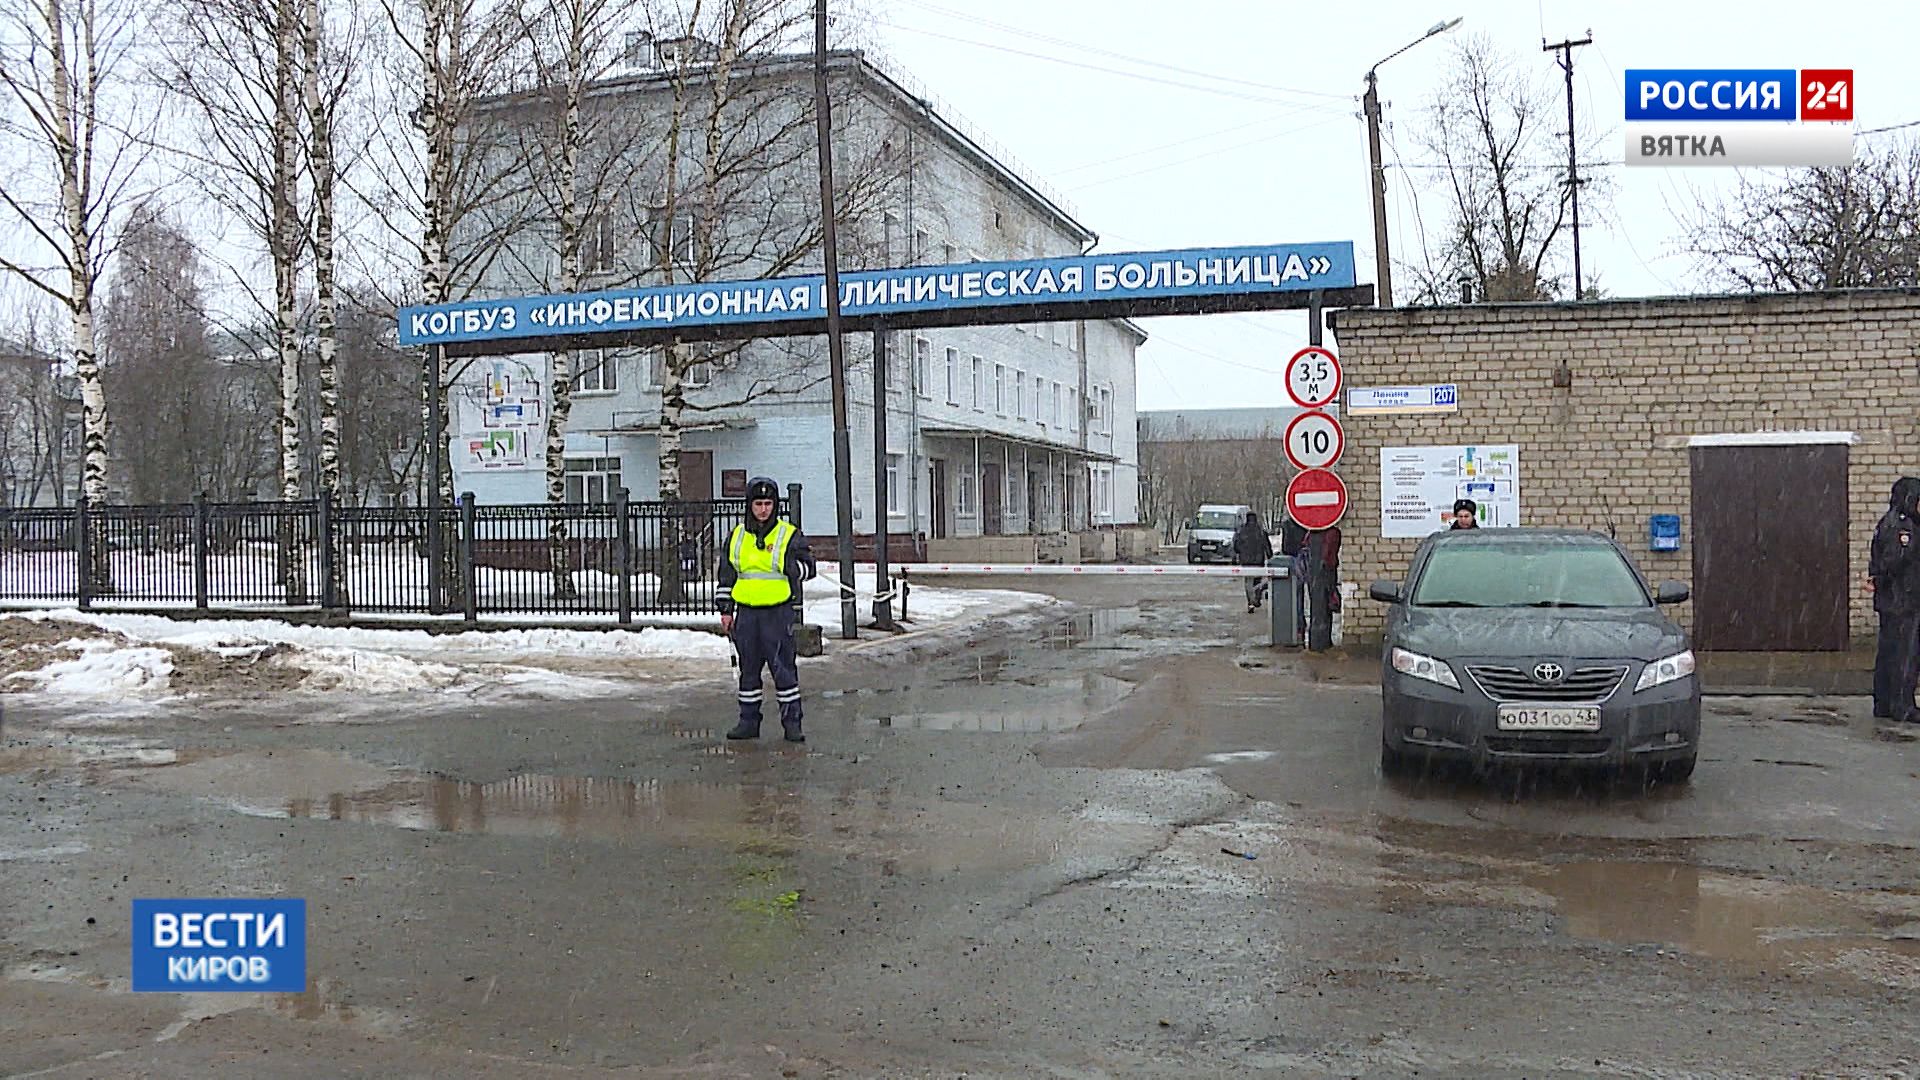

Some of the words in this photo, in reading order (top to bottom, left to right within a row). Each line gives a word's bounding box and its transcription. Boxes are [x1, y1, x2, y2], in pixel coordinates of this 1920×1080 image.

[411, 307, 517, 337] КОГБУЗ
[530, 285, 811, 329] «ИНФЕКЦИОННАЯ
[1094, 254, 1333, 291] БОЛЬНИЦА»
[1299, 363, 1329, 384] 3,5
[1435, 387, 1455, 402] 207
[1300, 430, 1330, 455] 10
